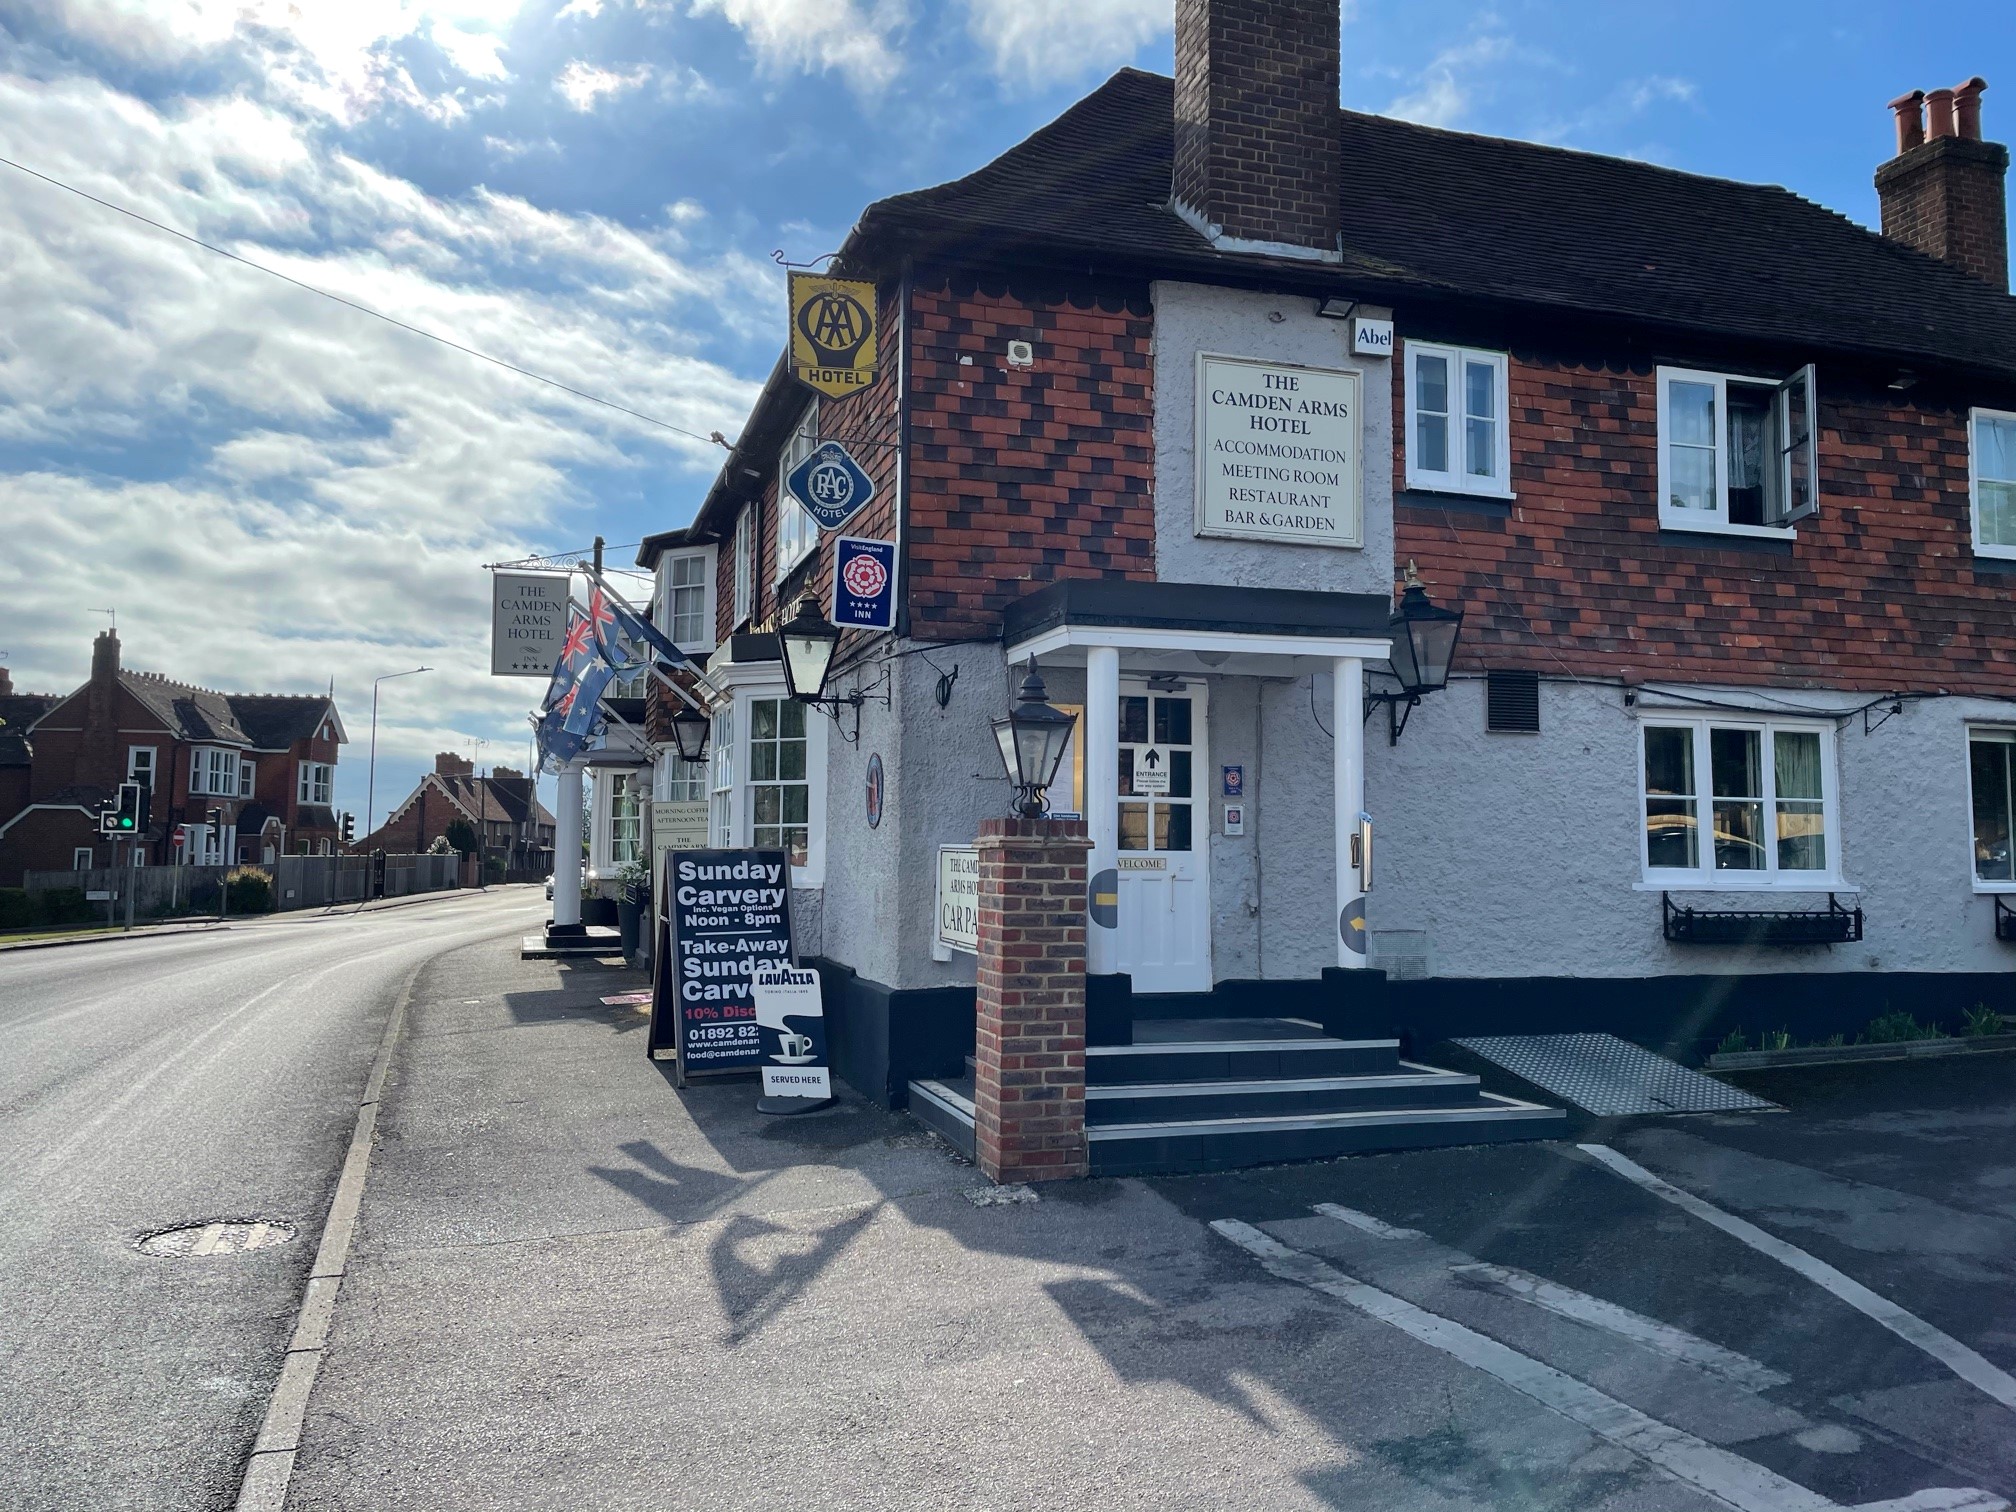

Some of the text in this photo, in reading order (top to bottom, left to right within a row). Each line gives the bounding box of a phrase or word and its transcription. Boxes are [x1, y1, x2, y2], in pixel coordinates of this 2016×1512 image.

[1357, 327, 1391, 346] Abel
[808, 369, 865, 385] HOTEL
[1262, 373, 1300, 391] THE
[1212, 389, 1348, 418] CAMDEN ARMS
[1249, 415, 1311, 435] HOTEL
[1213, 438, 1347, 464] ACCOMMODATION
[1222, 463, 1339, 486] MEETING ROOM
[816, 468, 847, 500] RAC
[1229, 487, 1331, 508] RESTAURANT
[813, 505, 849, 519] HOTEL
[1225, 509, 1336, 531] BAR & GARDEN
[518, 585, 546, 597] THE
[501, 599, 561, 612] CAMDEN
[854, 609, 872, 619] INN
[512, 615, 551, 626] ARMS
[508, 628, 554, 641] HOTEL
[679, 861, 781, 884] Sunday
[950, 858, 961, 873] THE
[950, 879, 966, 894] ARMS
[677, 886, 785, 908] Carvery
[711, 905, 738, 914] Vegan
[740, 904, 773, 912] Options
[943, 902, 963, 933] CAR
[685, 914, 729, 926] Noon
[744, 912, 781, 927] 8pm
[680, 938, 789, 955] Take-Away
[758, 968, 815, 986] LAVAZZA
[682, 980, 755, 1001] Carv
[685, 1007, 719, 1020] 10%
[689, 1025, 759, 1041] 01892 82
[771, 1075, 822, 1085] SERVED HERE
